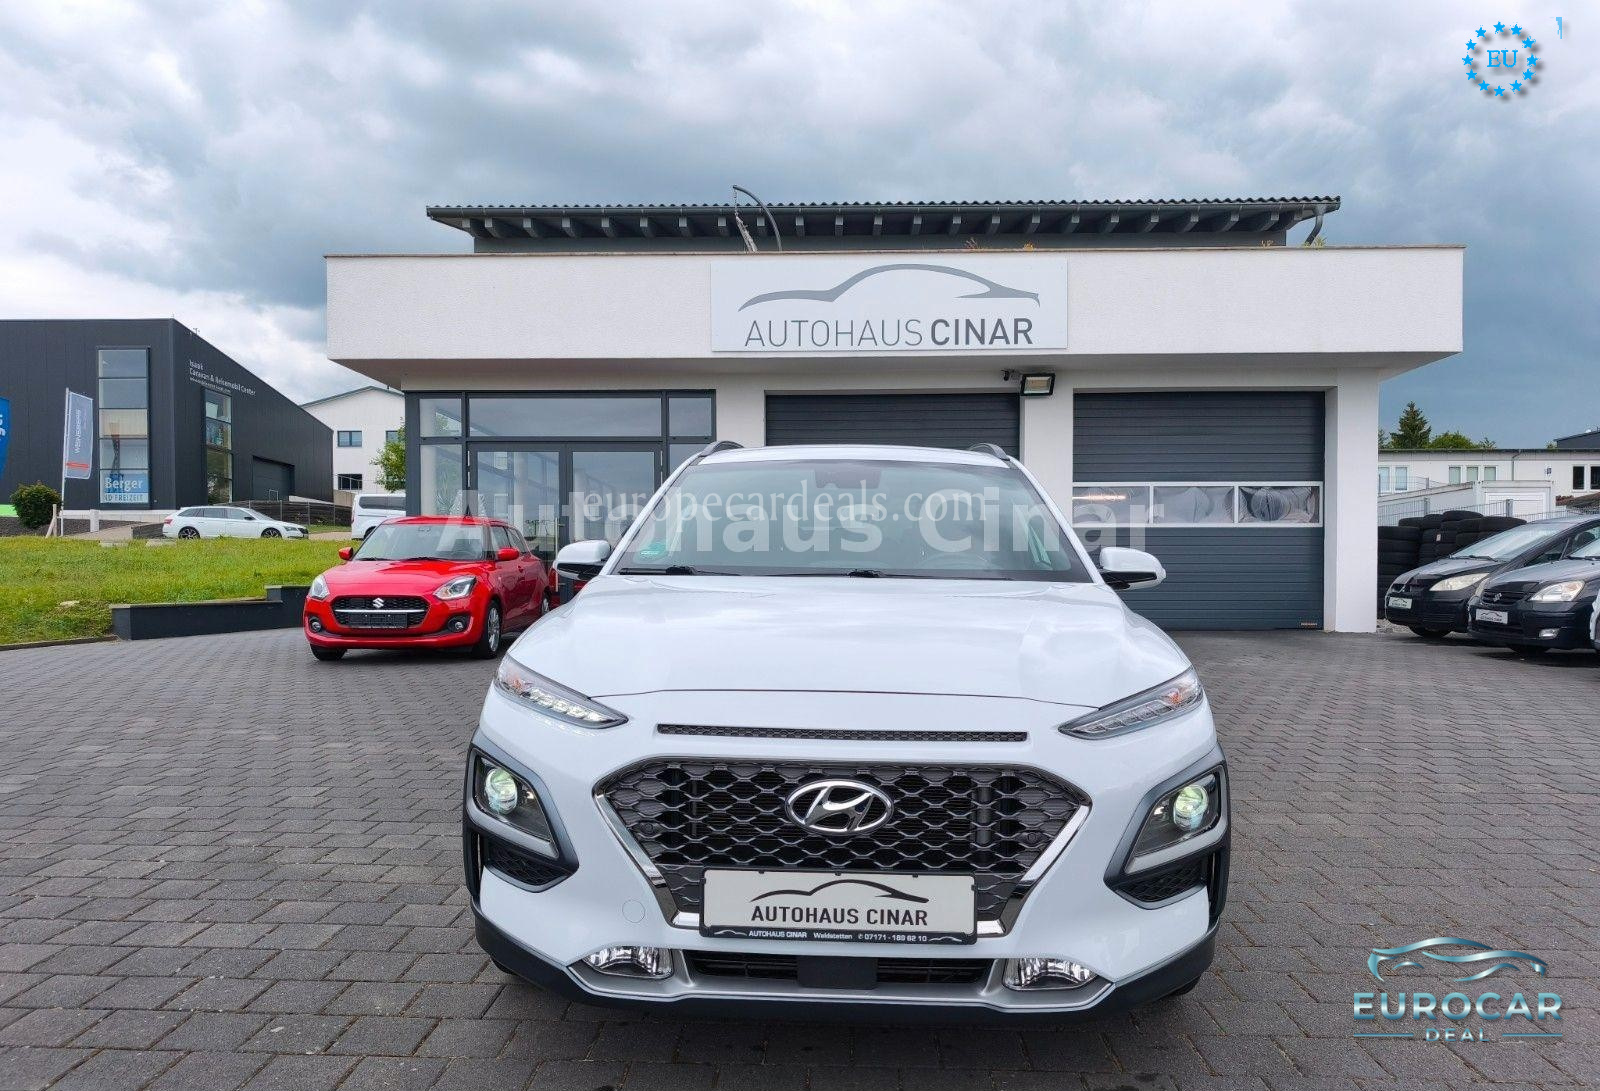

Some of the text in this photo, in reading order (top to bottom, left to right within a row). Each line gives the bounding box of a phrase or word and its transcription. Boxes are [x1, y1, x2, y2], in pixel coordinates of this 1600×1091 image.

[744, 317, 1033, 347] AUTOHAUS CINAR
[104, 477, 143, 492] Berger
[751, 905, 929, 926] AUTOHAUS CINAR
[748, 930, 785, 938] AUTOHAUS
[786, 931, 807, 939] CINAR
[864, 933, 887, 941] 07171
